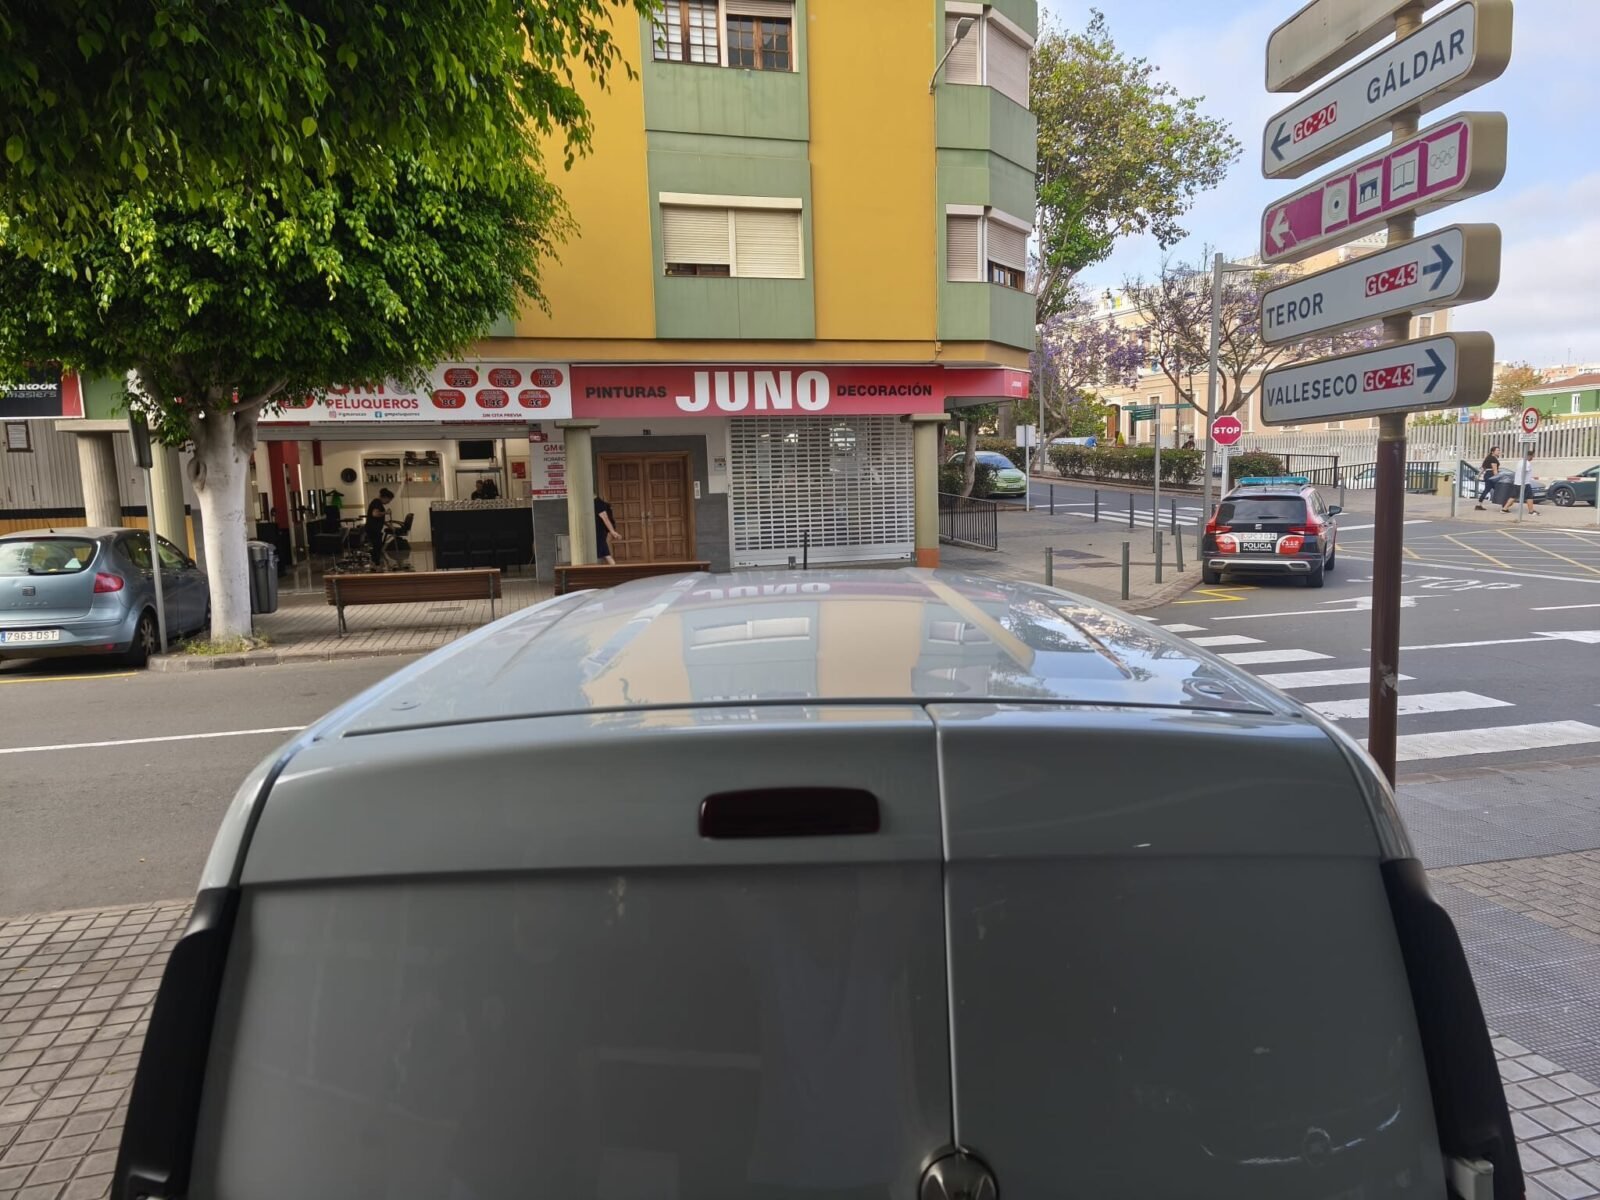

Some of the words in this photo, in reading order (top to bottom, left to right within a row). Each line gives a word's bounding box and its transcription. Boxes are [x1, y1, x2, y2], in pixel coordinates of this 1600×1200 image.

[1293, 102, 1337, 141] GC-20
[1367, 29, 1464, 103] GÁLDAR
[1266, 293, 1324, 328] TEROR
[1366, 264, 1418, 296] GC-43
[585, 386, 667, 399] PINTURAS
[675, 371, 830, 412] JUNO
[836, 383, 932, 397] DECORACIÓN
[1267, 374, 1357, 407] VALLESECO
[1364, 365, 1414, 391] GC-43
[326, 399, 419, 409] PELUQUEROS
[1213, 426, 1240, 435] STOP
[7, 632, 33, 641] 7963
[36, 631, 57, 640] DST
